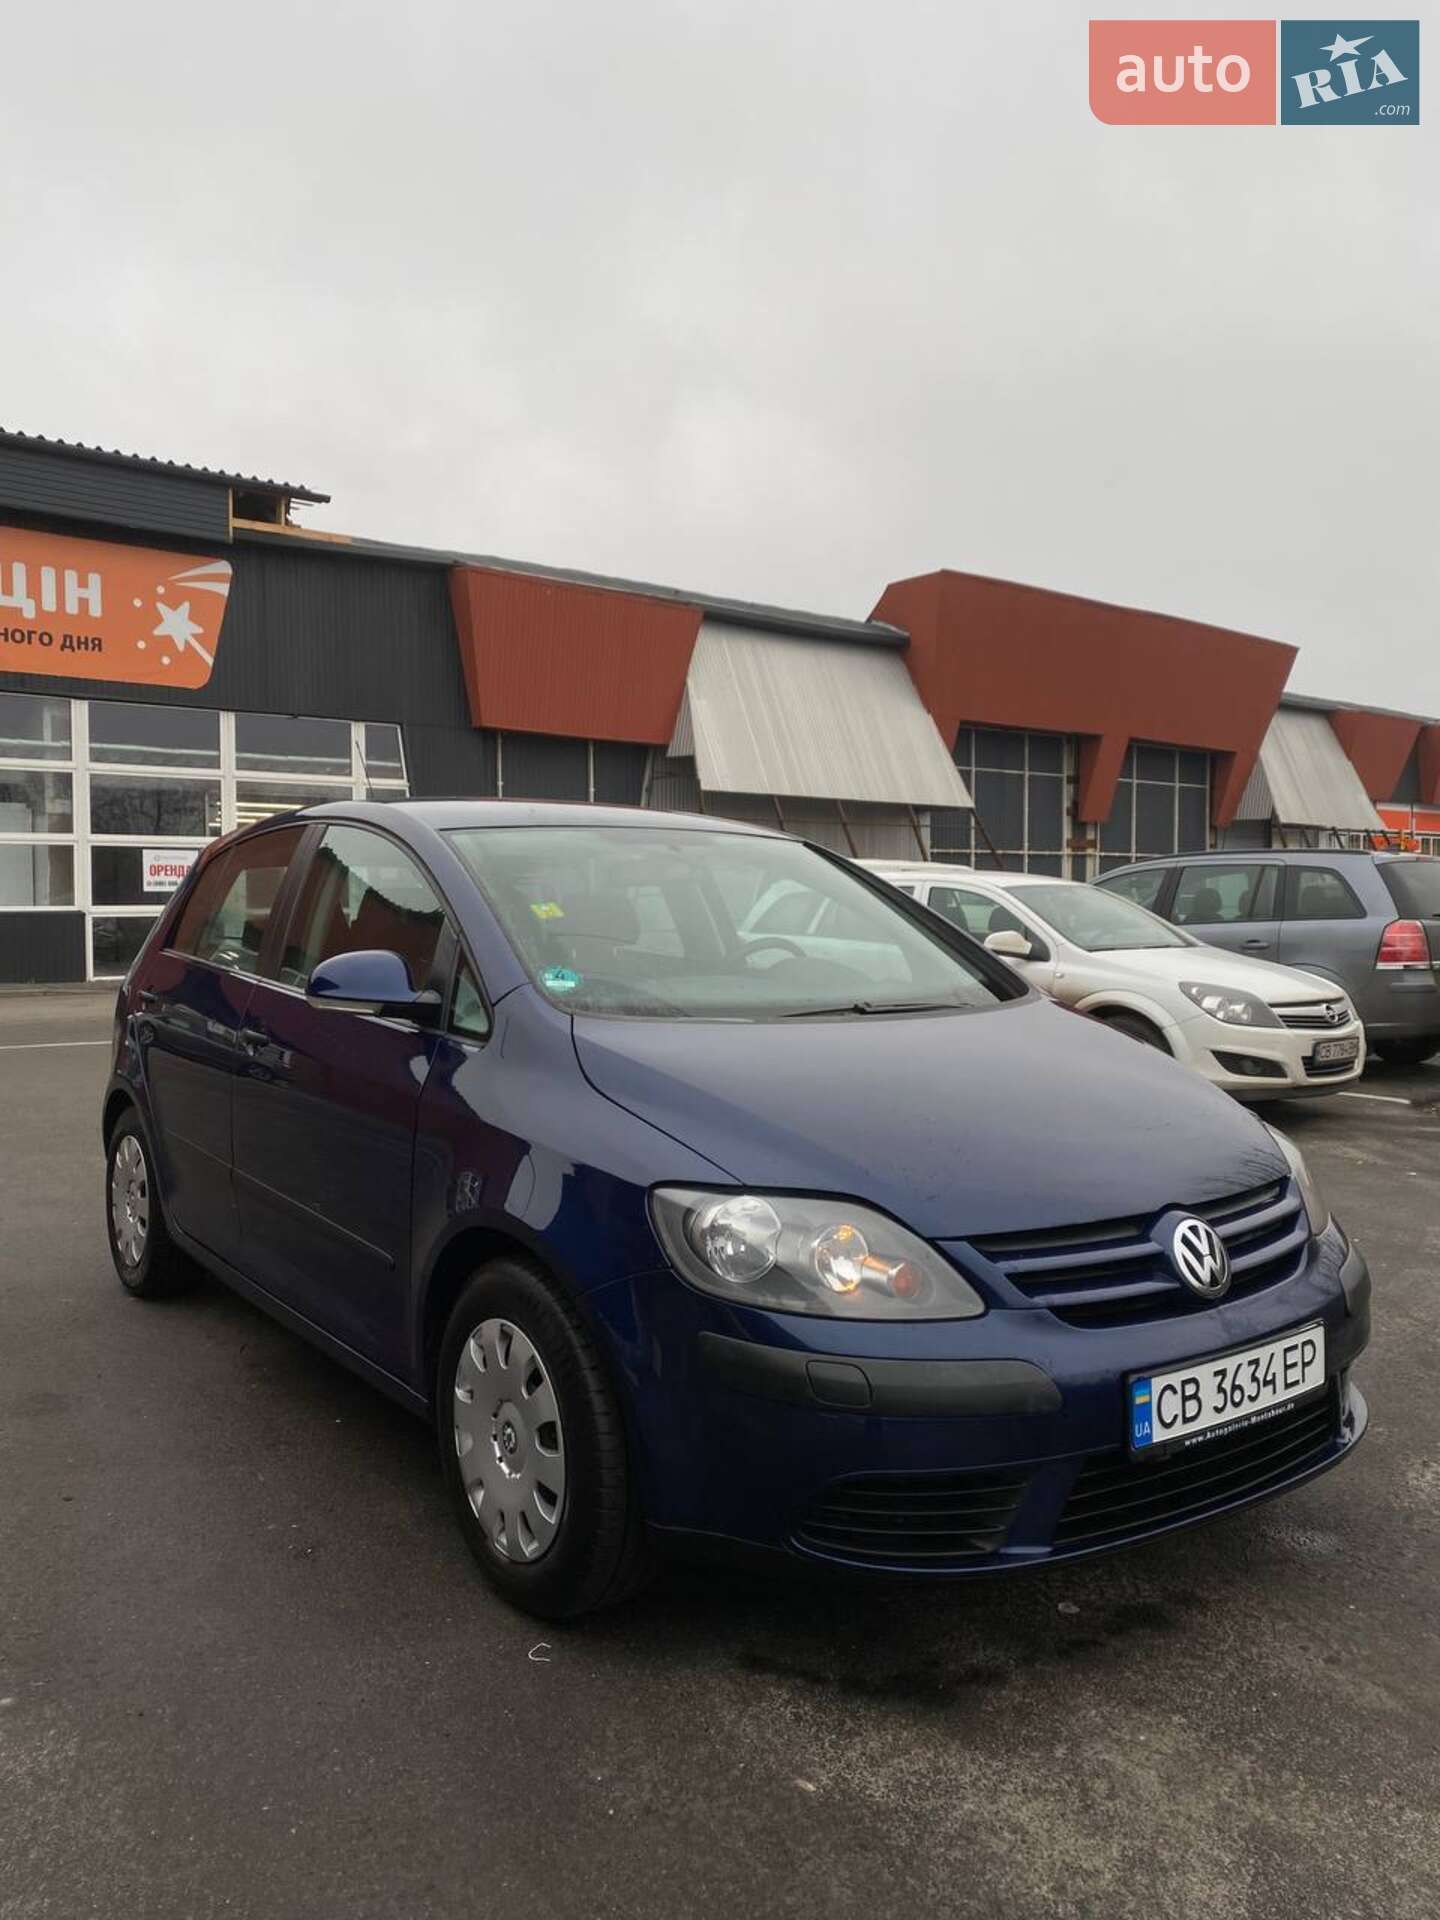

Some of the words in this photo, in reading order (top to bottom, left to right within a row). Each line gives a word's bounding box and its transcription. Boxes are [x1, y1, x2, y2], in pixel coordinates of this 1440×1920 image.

[0, 562, 102, 619] ЦІН
[60, 633, 103, 652] дня
[1157, 1376, 1203, 1430] CB
[1134, 1421, 1151, 1438] UA
